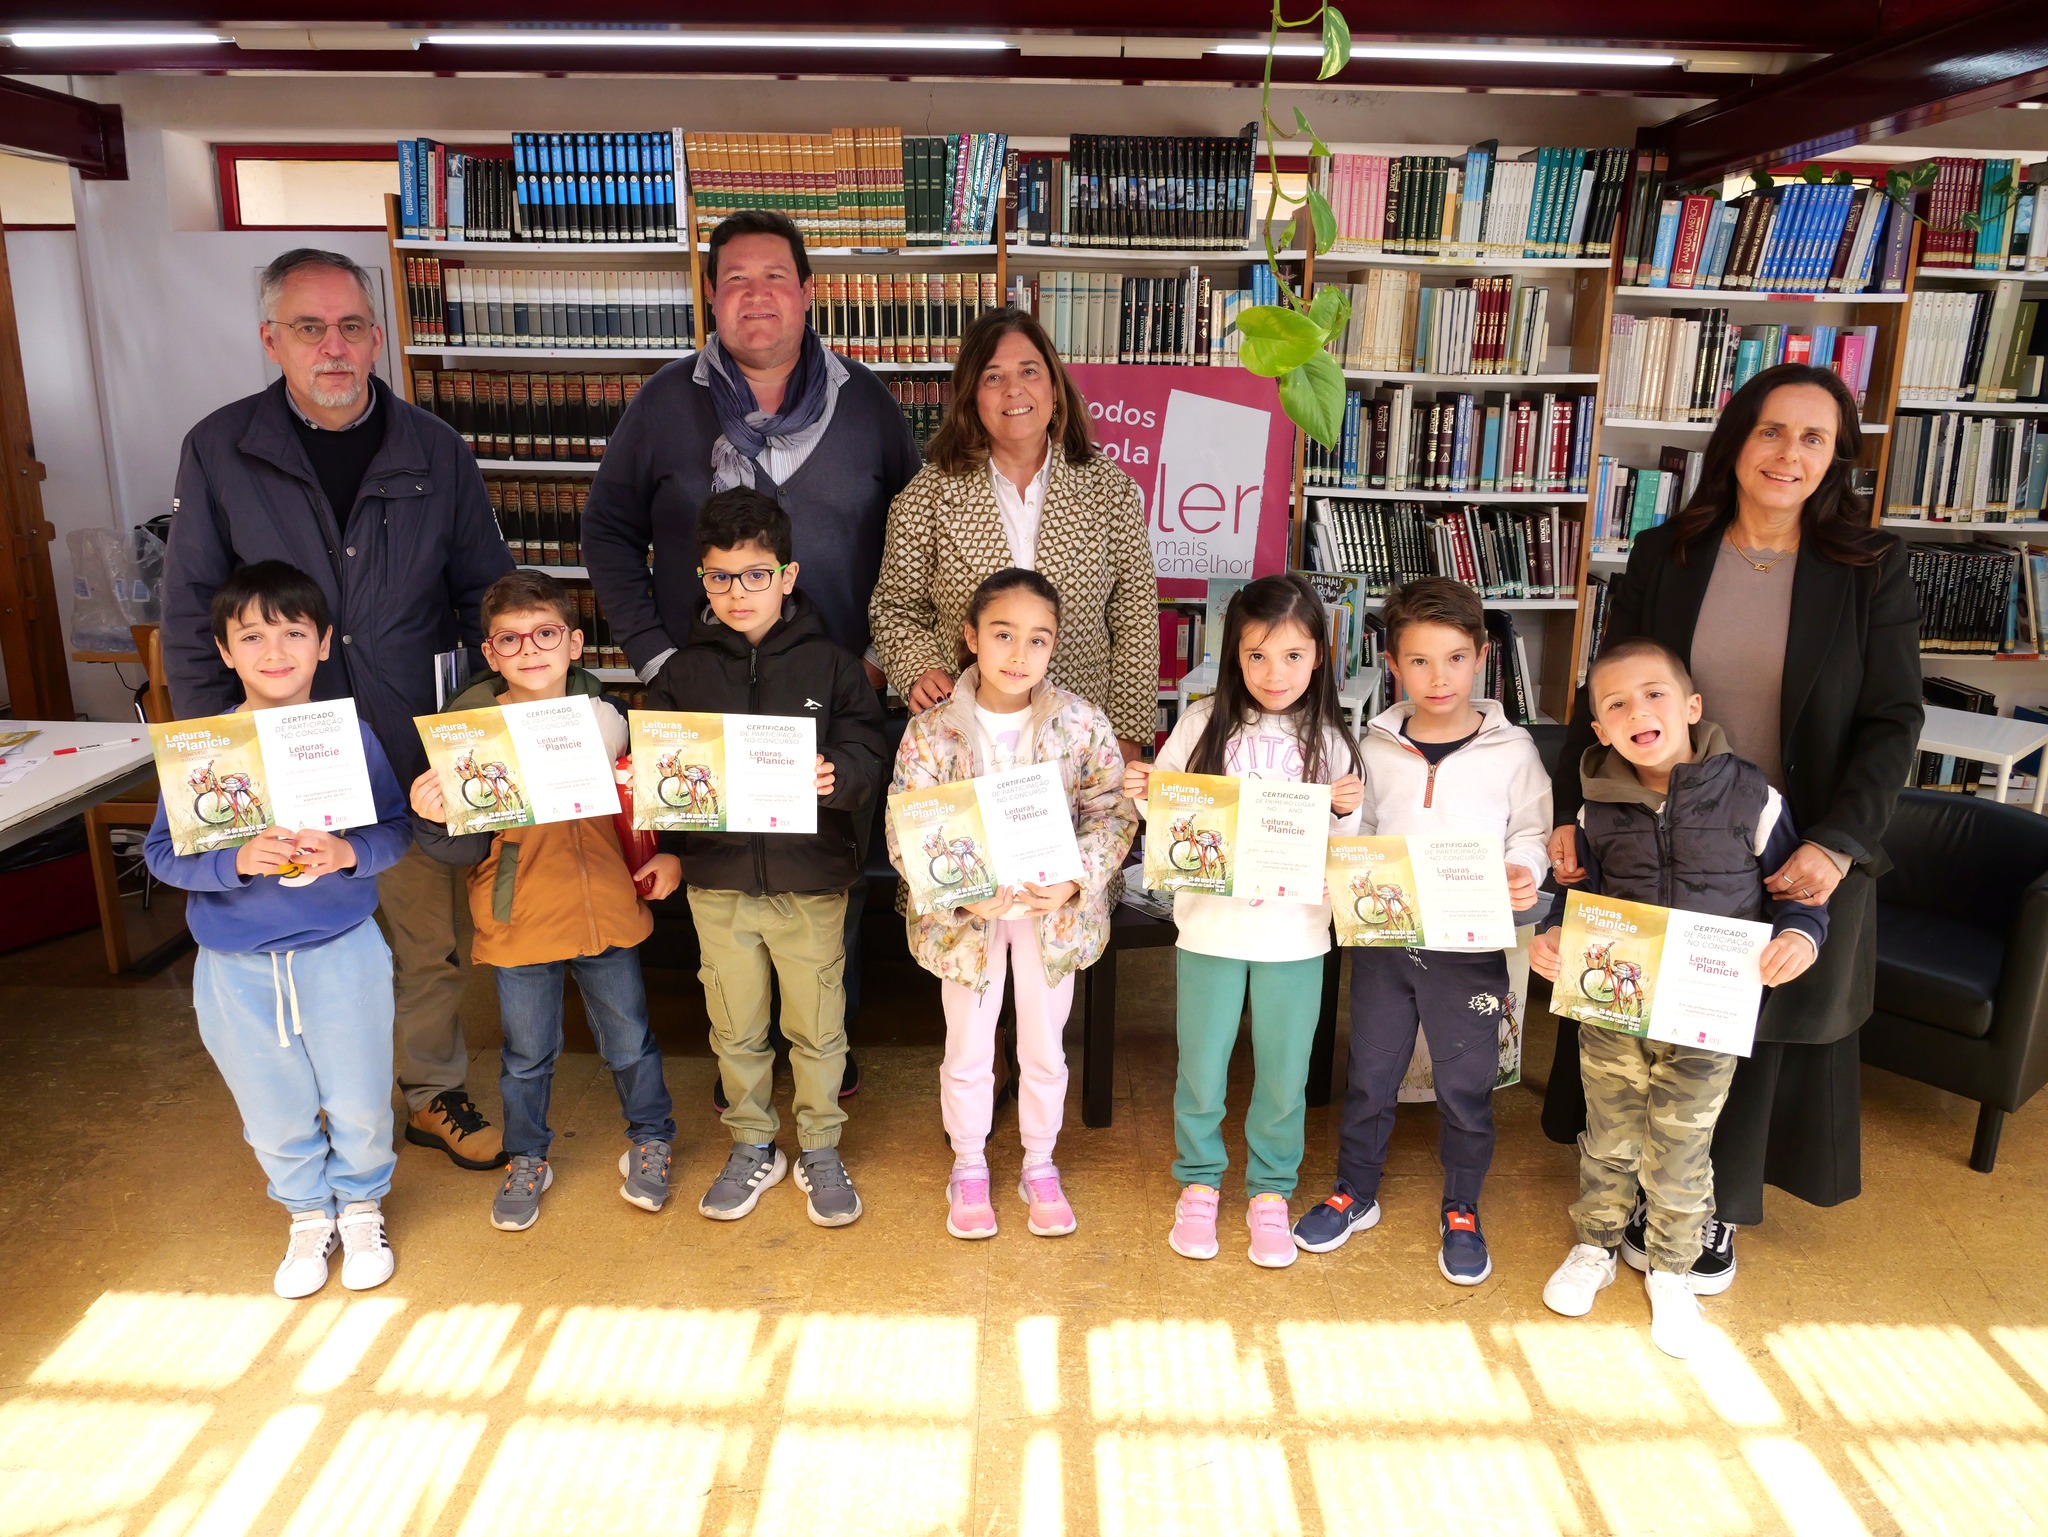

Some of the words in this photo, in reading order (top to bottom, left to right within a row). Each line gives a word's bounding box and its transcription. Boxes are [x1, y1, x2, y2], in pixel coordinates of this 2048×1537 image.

[418, 142, 427, 184] MARAVILHAS
[403, 165, 414, 215] conhecimento
[420, 187, 427, 195] DA
[1531, 228, 1537, 237] AS
[1536, 166, 1546, 201] HUMANAS
[1541, 229, 1547, 239] AS
[1547, 167, 1559, 202] HUMANAS
[1552, 229, 1558, 238] AS
[1557, 167, 1569, 203] HUMANAS
[1562, 228, 1569, 238] AS
[1569, 167, 1581, 202] HUMANAS
[420, 198, 428, 224] CIÊNCIA
[1845, 204, 1857, 231] DIDACTA
[1681, 232, 1693, 262] MANUAL
[1688, 205, 1698, 230] MERCK
[1655, 241, 1664, 267] MANUAL
[1084, 397, 1156, 428] odos
[1158, 463, 1260, 535] ler
[1156, 537, 1207, 556] mais
[1948, 559, 1958, 590] CHAGALL
[1965, 559, 1973, 578] GOYA
[1977, 560, 1986, 583] MONET
[1990, 561, 2000, 590] PICASSO
[2005, 561, 2013, 582] DEGAS
[1311, 576, 1344, 589] ANIMAIS
[1995, 562, 2005, 596] MODIGLIANI
[282, 712, 334, 724] CERTIFICADO
[526, 707, 572, 718] CERTIFICADO
[276, 725, 285, 733] DE
[288, 717, 343, 730] PARTICIPAÇÃO
[296, 726, 340, 737] CONCURSO
[430, 723, 467, 734] Leituras
[642, 721, 682, 730] Leituras
[165, 730, 211, 743] Leituras
[440, 728, 485, 742] Planície
[536, 736, 567, 745] Leituras
[652, 729, 698, 739] Planície
[177, 736, 231, 752] Planície
[289, 743, 324, 754] Leituras
[545, 740, 582, 751] Planície
[298, 748, 340, 761] Planície
[757, 757, 794, 765] Planície
[1224, 735, 1328, 784] TITC
[997, 775, 1041, 789] CERTIFICADO
[1003, 779, 1050, 795] PARTICIPAÇÃO
[1162, 784, 1200, 793] Leituras
[1009, 787, 1048, 800] CONCURSO
[1169, 792, 1214, 804] Planície
[1262, 792, 1310, 800] CERTIFICADO
[902, 799, 939, 811] Leituras
[912, 804, 955, 819] Planície
[1004, 804, 1035, 816] Leituras
[1013, 808, 1048, 822] Planície
[1262, 818, 1293, 826] Leituras
[1268, 826, 1305, 835] Planície
[1340, 852, 1385, 860] Planície
[1445, 873, 1484, 881] Planície
[1579, 903, 1622, 919] Leituras
[1586, 915, 1637, 933] Planície
[1694, 925, 1748, 938] CERTIFICADO
[1697, 933, 1755, 948] PARTICIPAÇÃO
[1702, 941, 1748, 955] CONCURSO
[1690, 954, 1726, 966] Leituras
[1696, 963, 1739, 977] Planície
